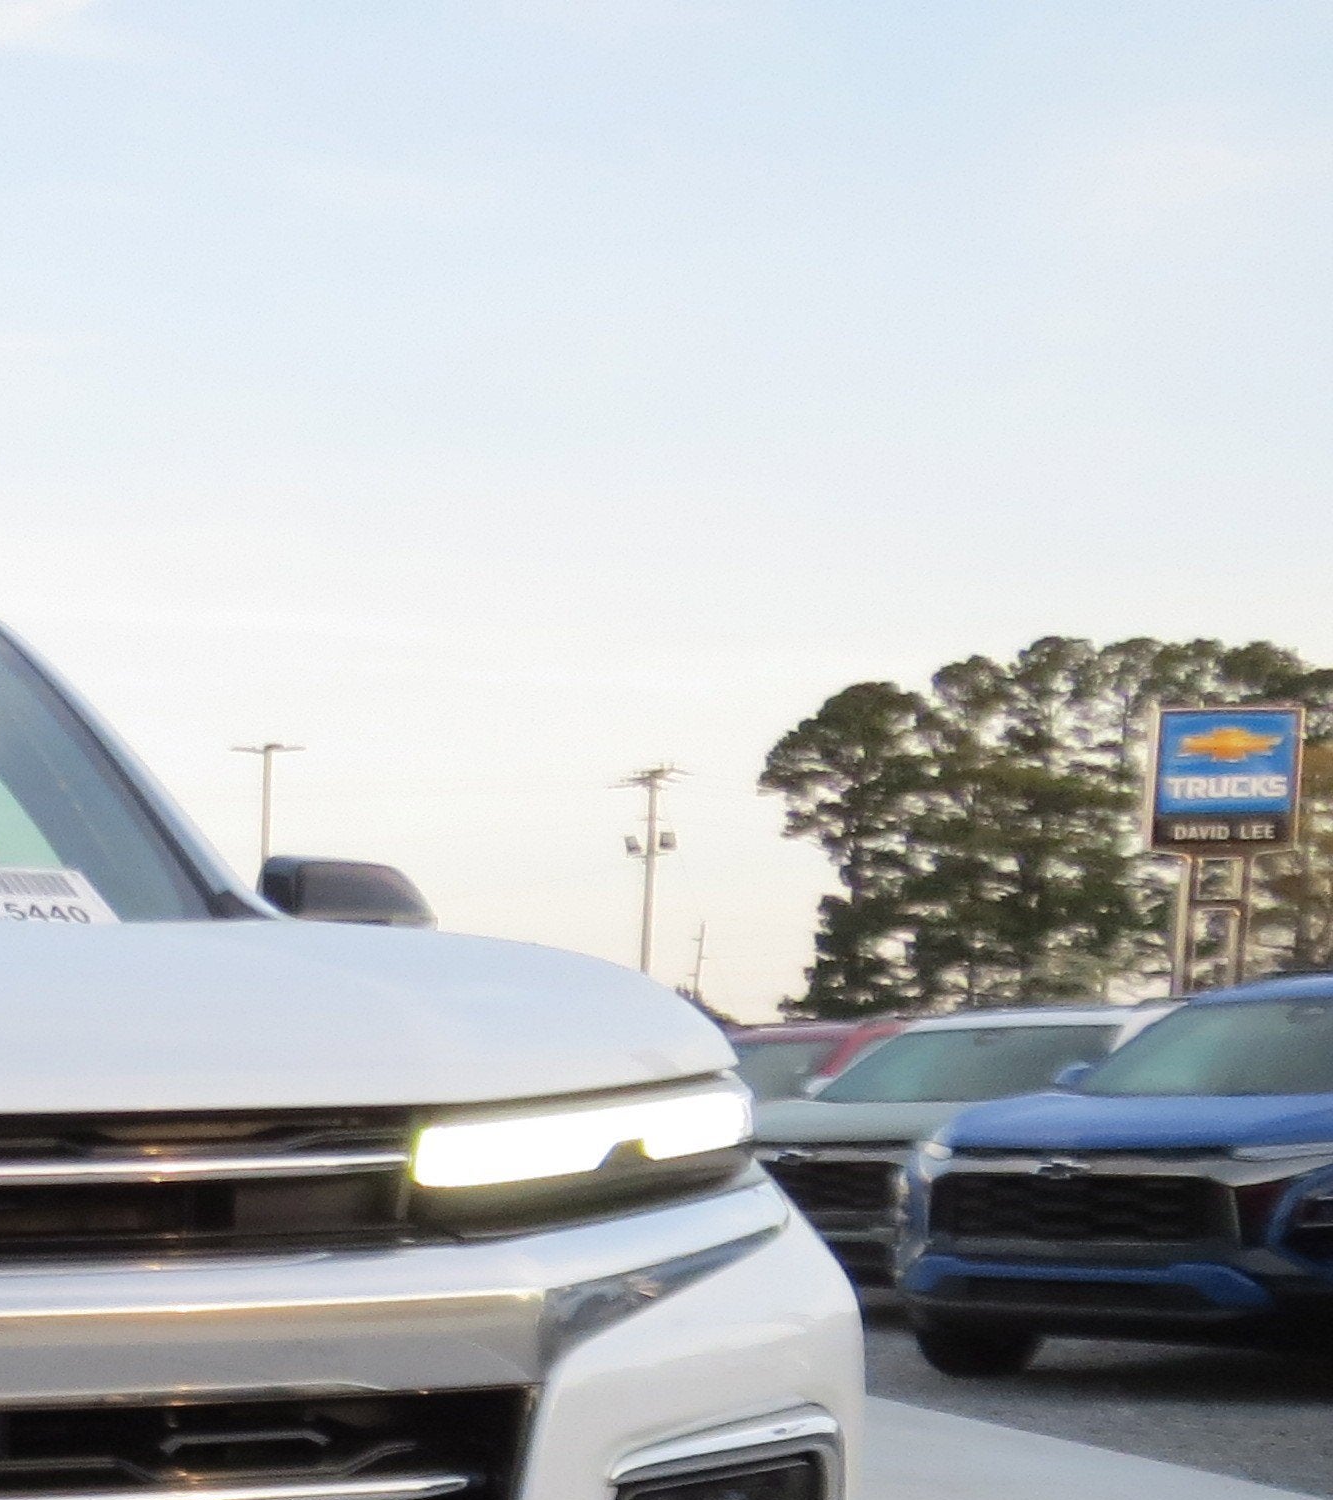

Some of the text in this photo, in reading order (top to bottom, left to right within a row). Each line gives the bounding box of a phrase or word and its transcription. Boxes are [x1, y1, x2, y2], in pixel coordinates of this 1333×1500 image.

[1166, 776, 1288, 799] TRUCKS
[1174, 824, 1276, 840] DAVID LEE
[4, 903, 90, 924] 5440
